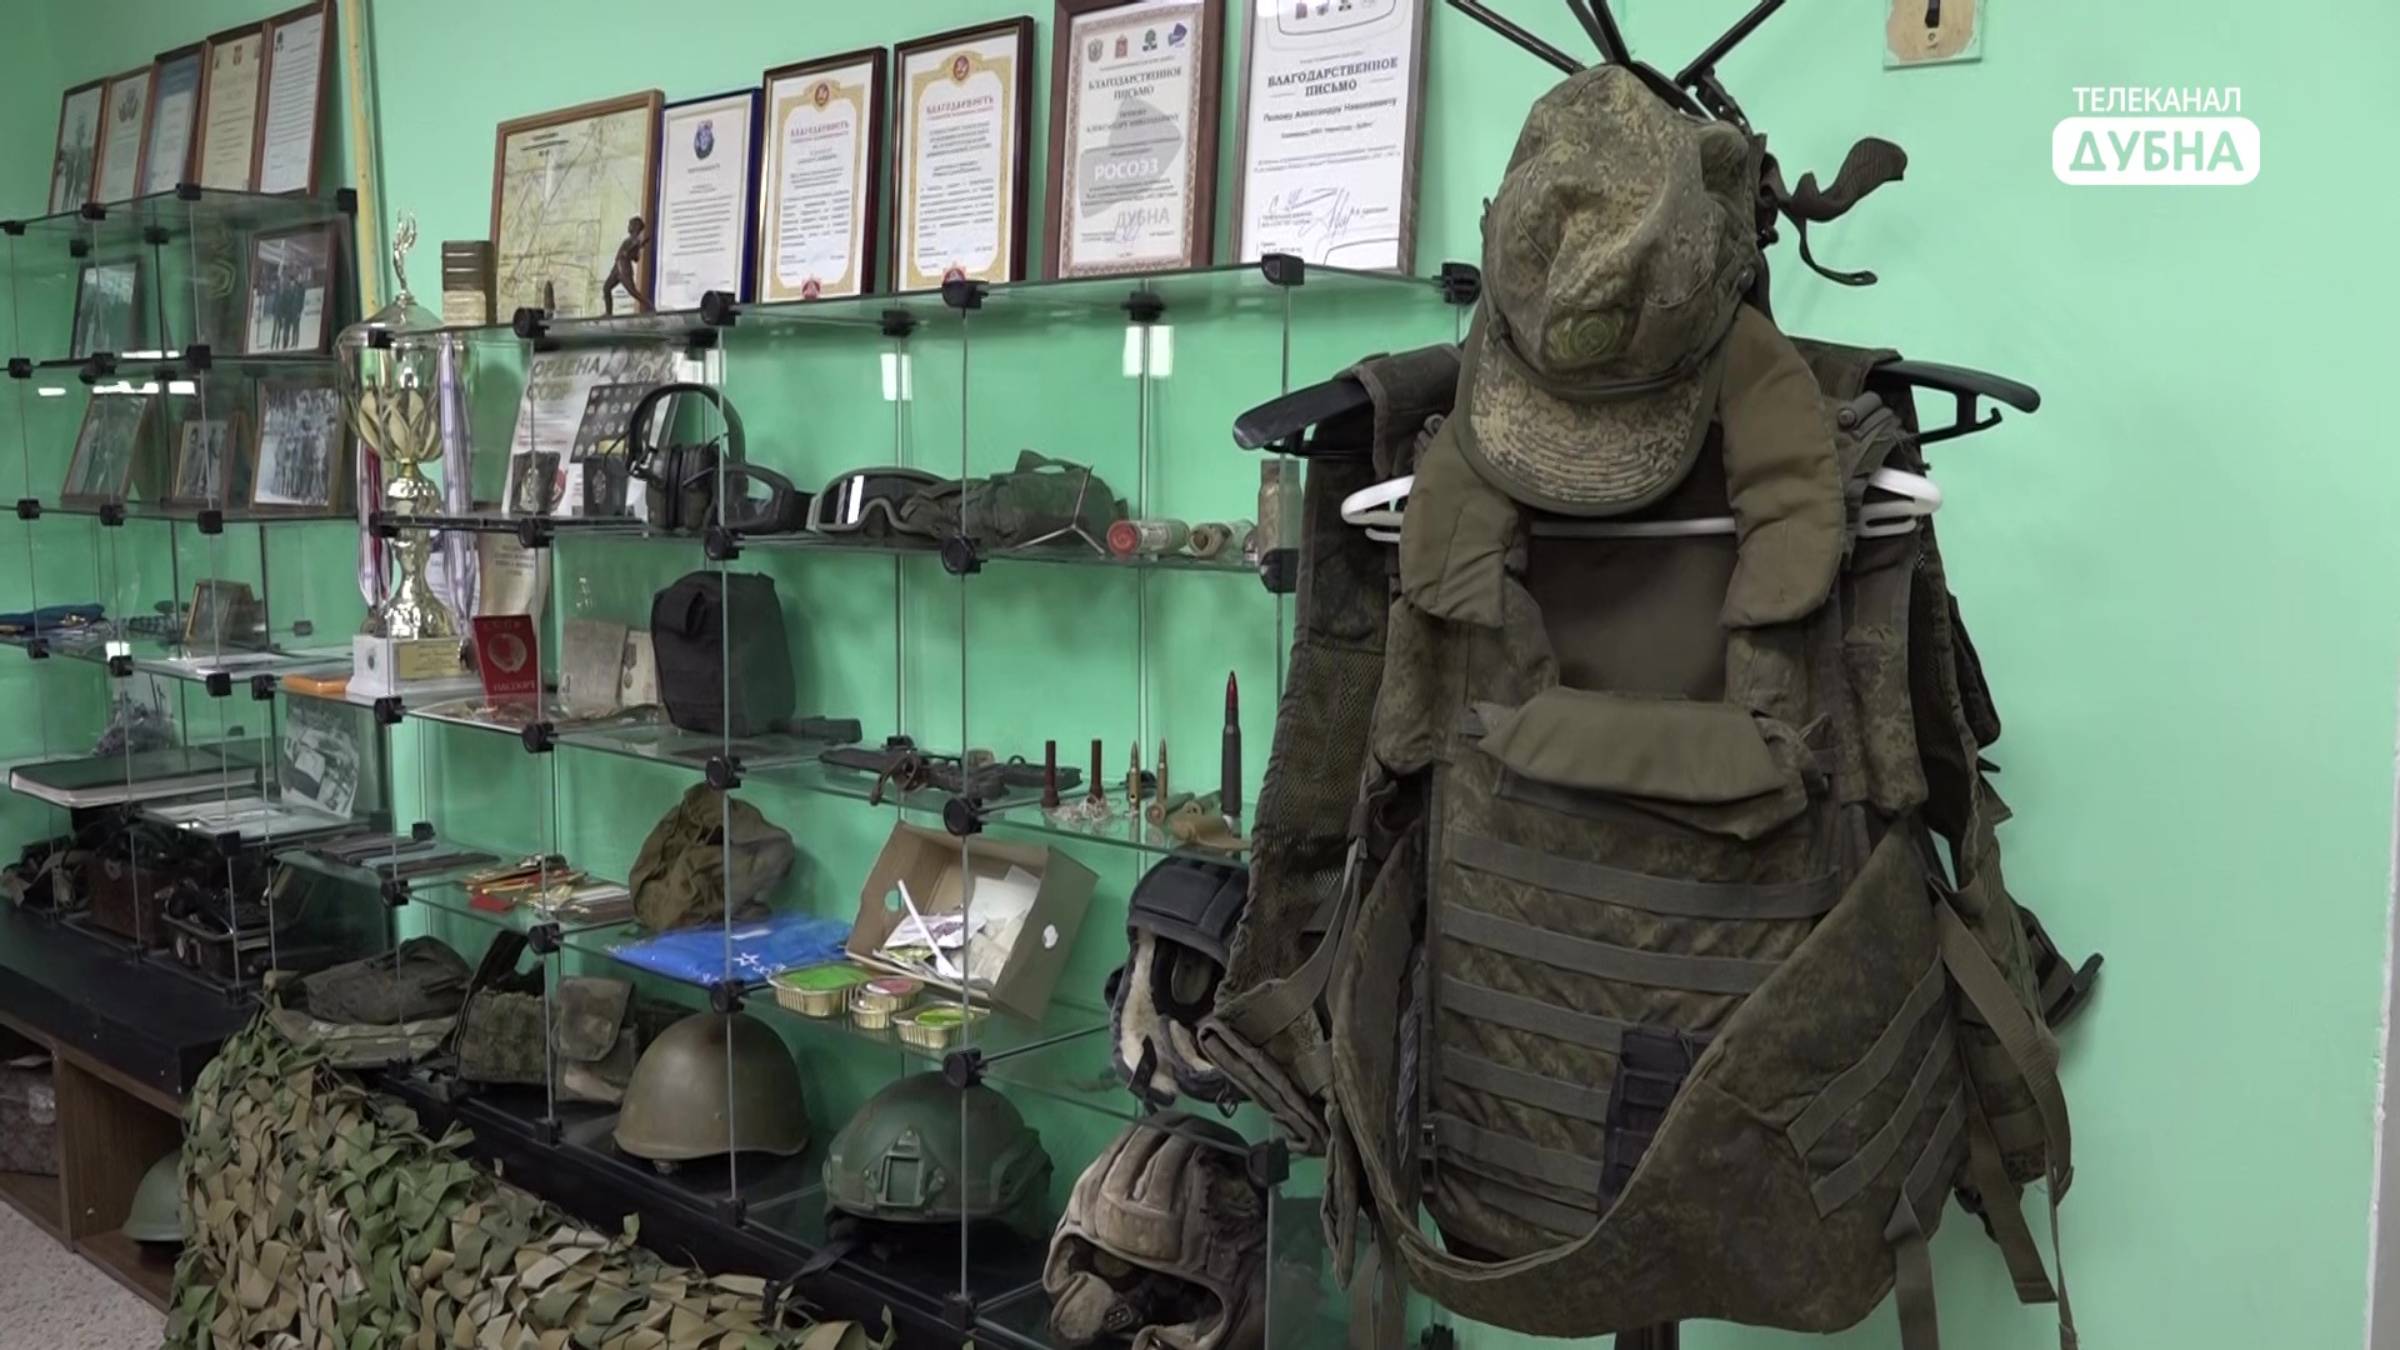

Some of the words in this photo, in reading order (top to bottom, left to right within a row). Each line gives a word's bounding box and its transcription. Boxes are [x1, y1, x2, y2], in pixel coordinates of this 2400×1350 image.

[1267, 57, 1399, 88] БЛАГОДАРСТВЕННОЕ
[1305, 79, 1358, 97] ПИСЬМО
[1116, 207, 1170, 228] ДУБНА
